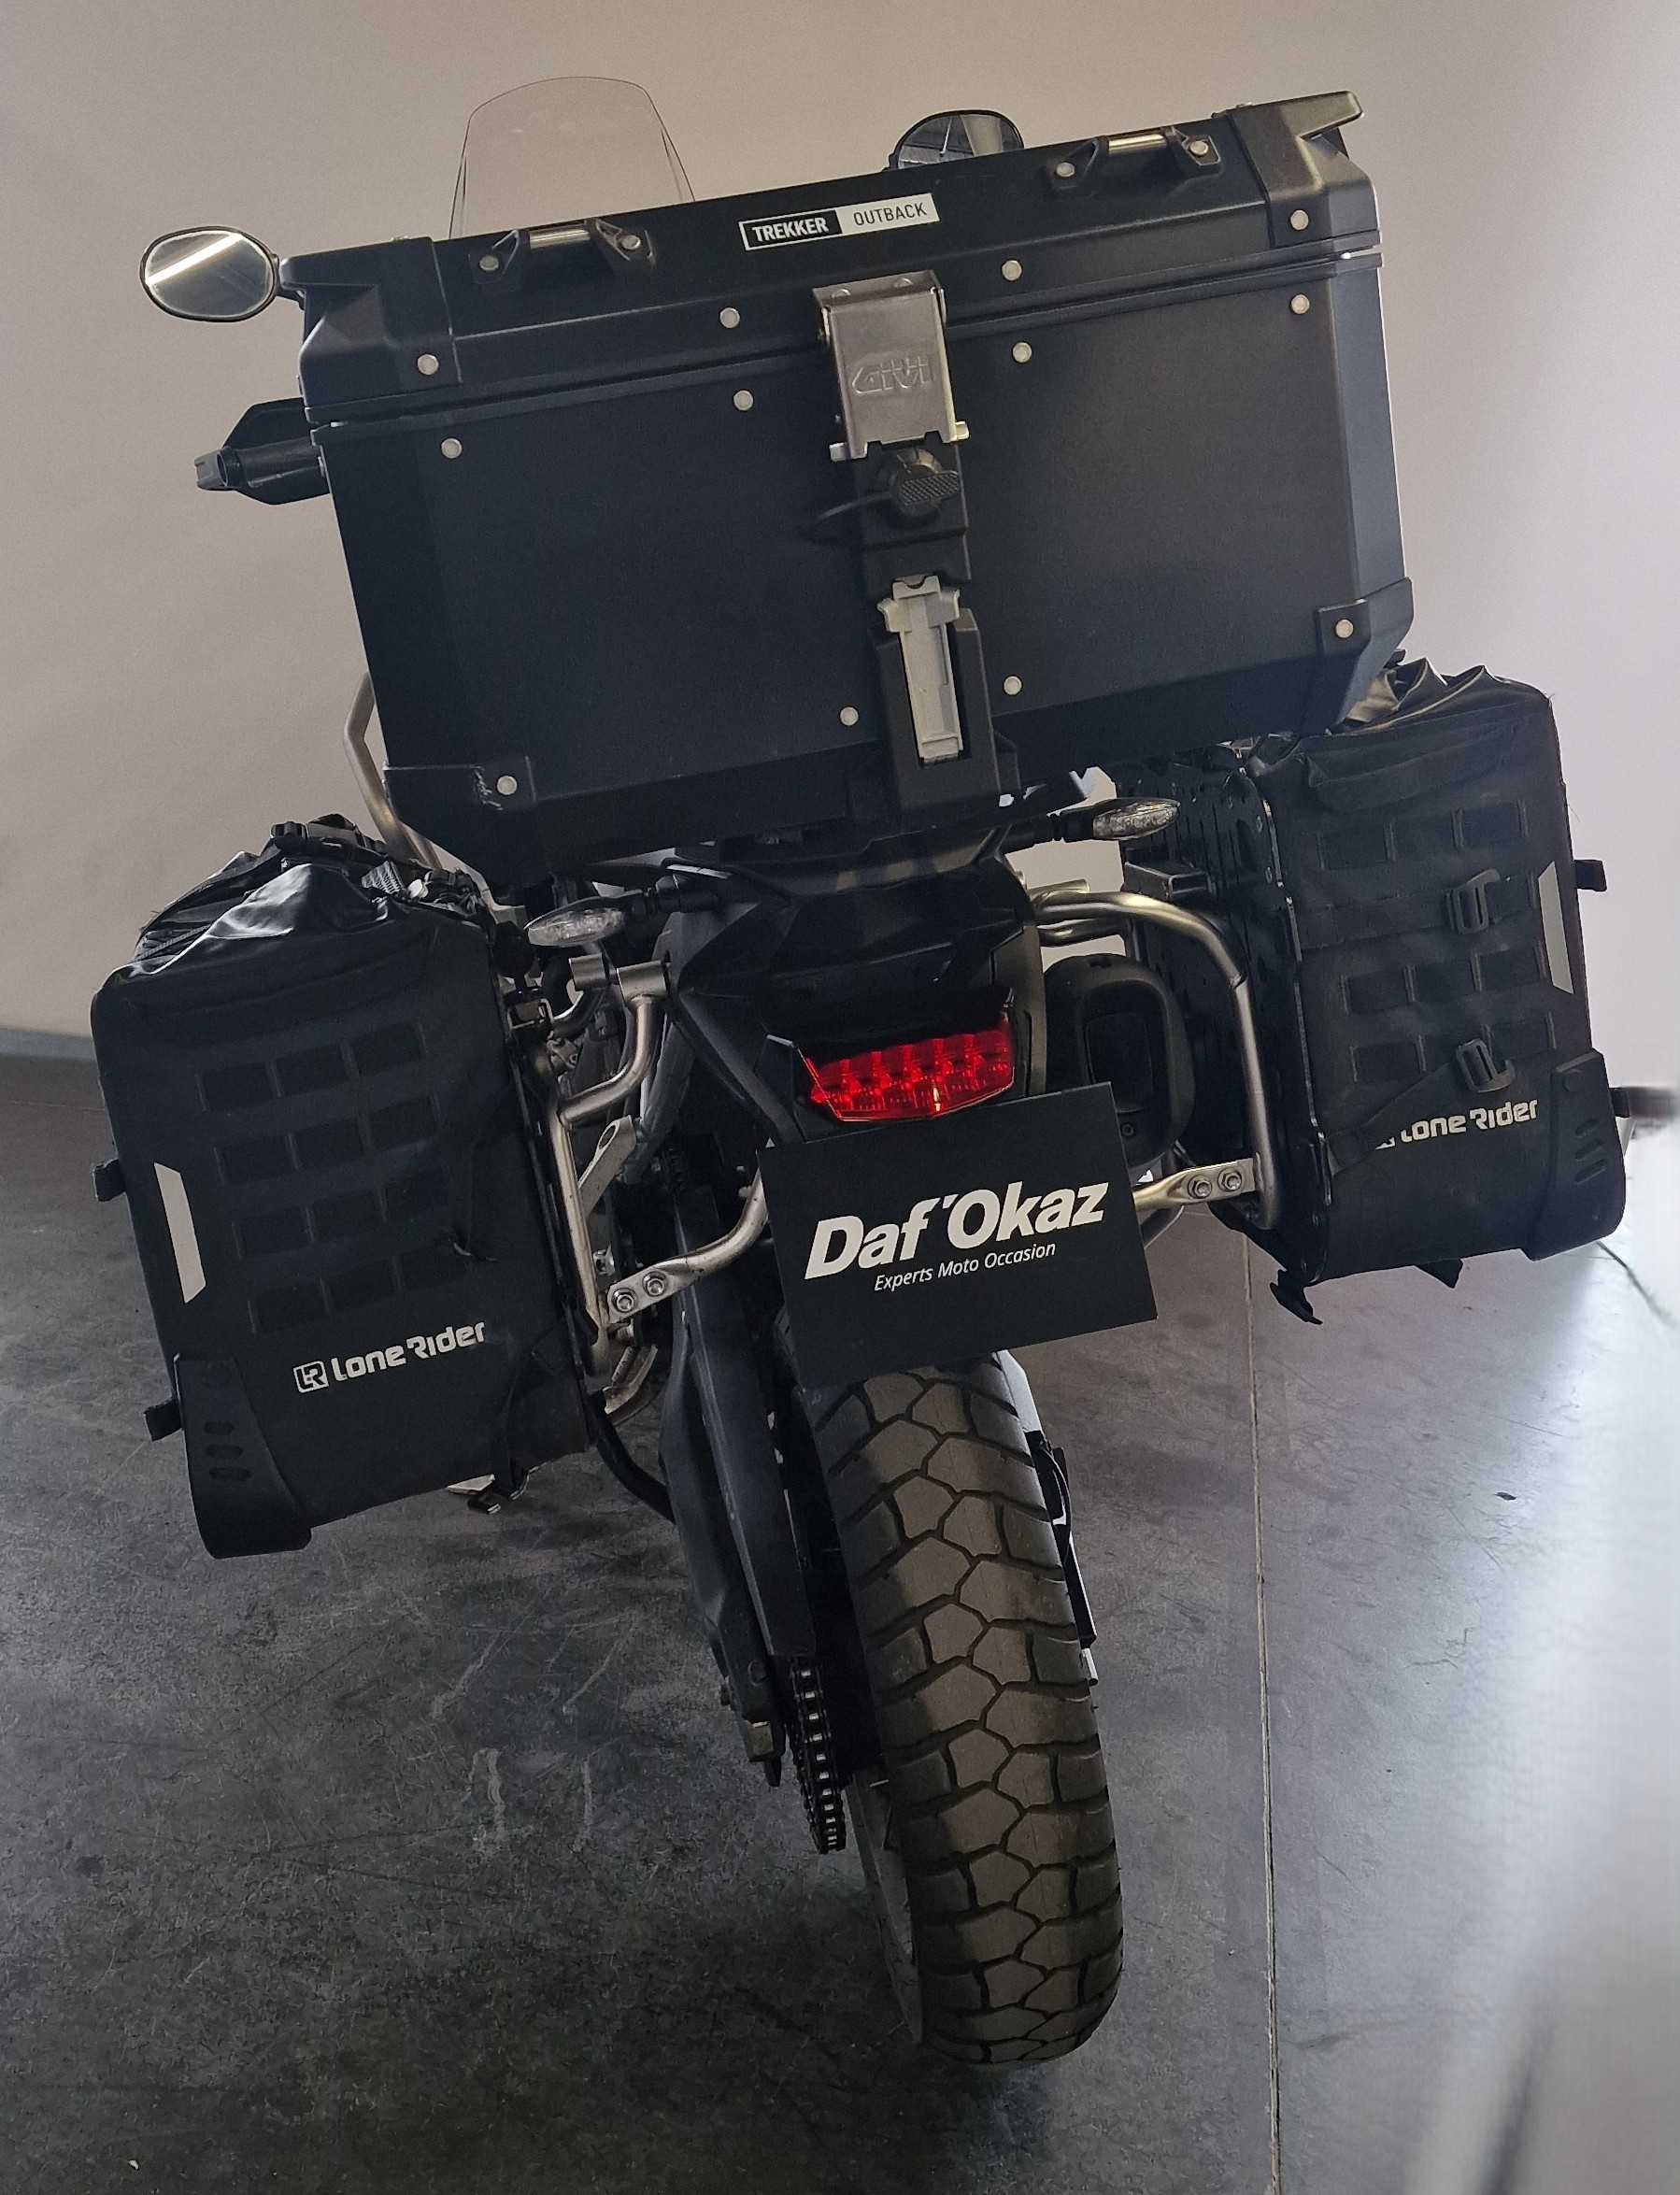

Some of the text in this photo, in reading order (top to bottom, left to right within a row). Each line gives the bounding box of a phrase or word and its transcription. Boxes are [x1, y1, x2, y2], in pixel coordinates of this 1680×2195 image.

[752, 202, 928, 242] TREKKER OUTBACK
[1469, 1099, 1539, 1130] Rider
[874, 1243, 1056, 1292] Experts Moto Occasion
[331, 1345, 406, 1381] Lone
[406, 1322, 485, 1359] Rider
